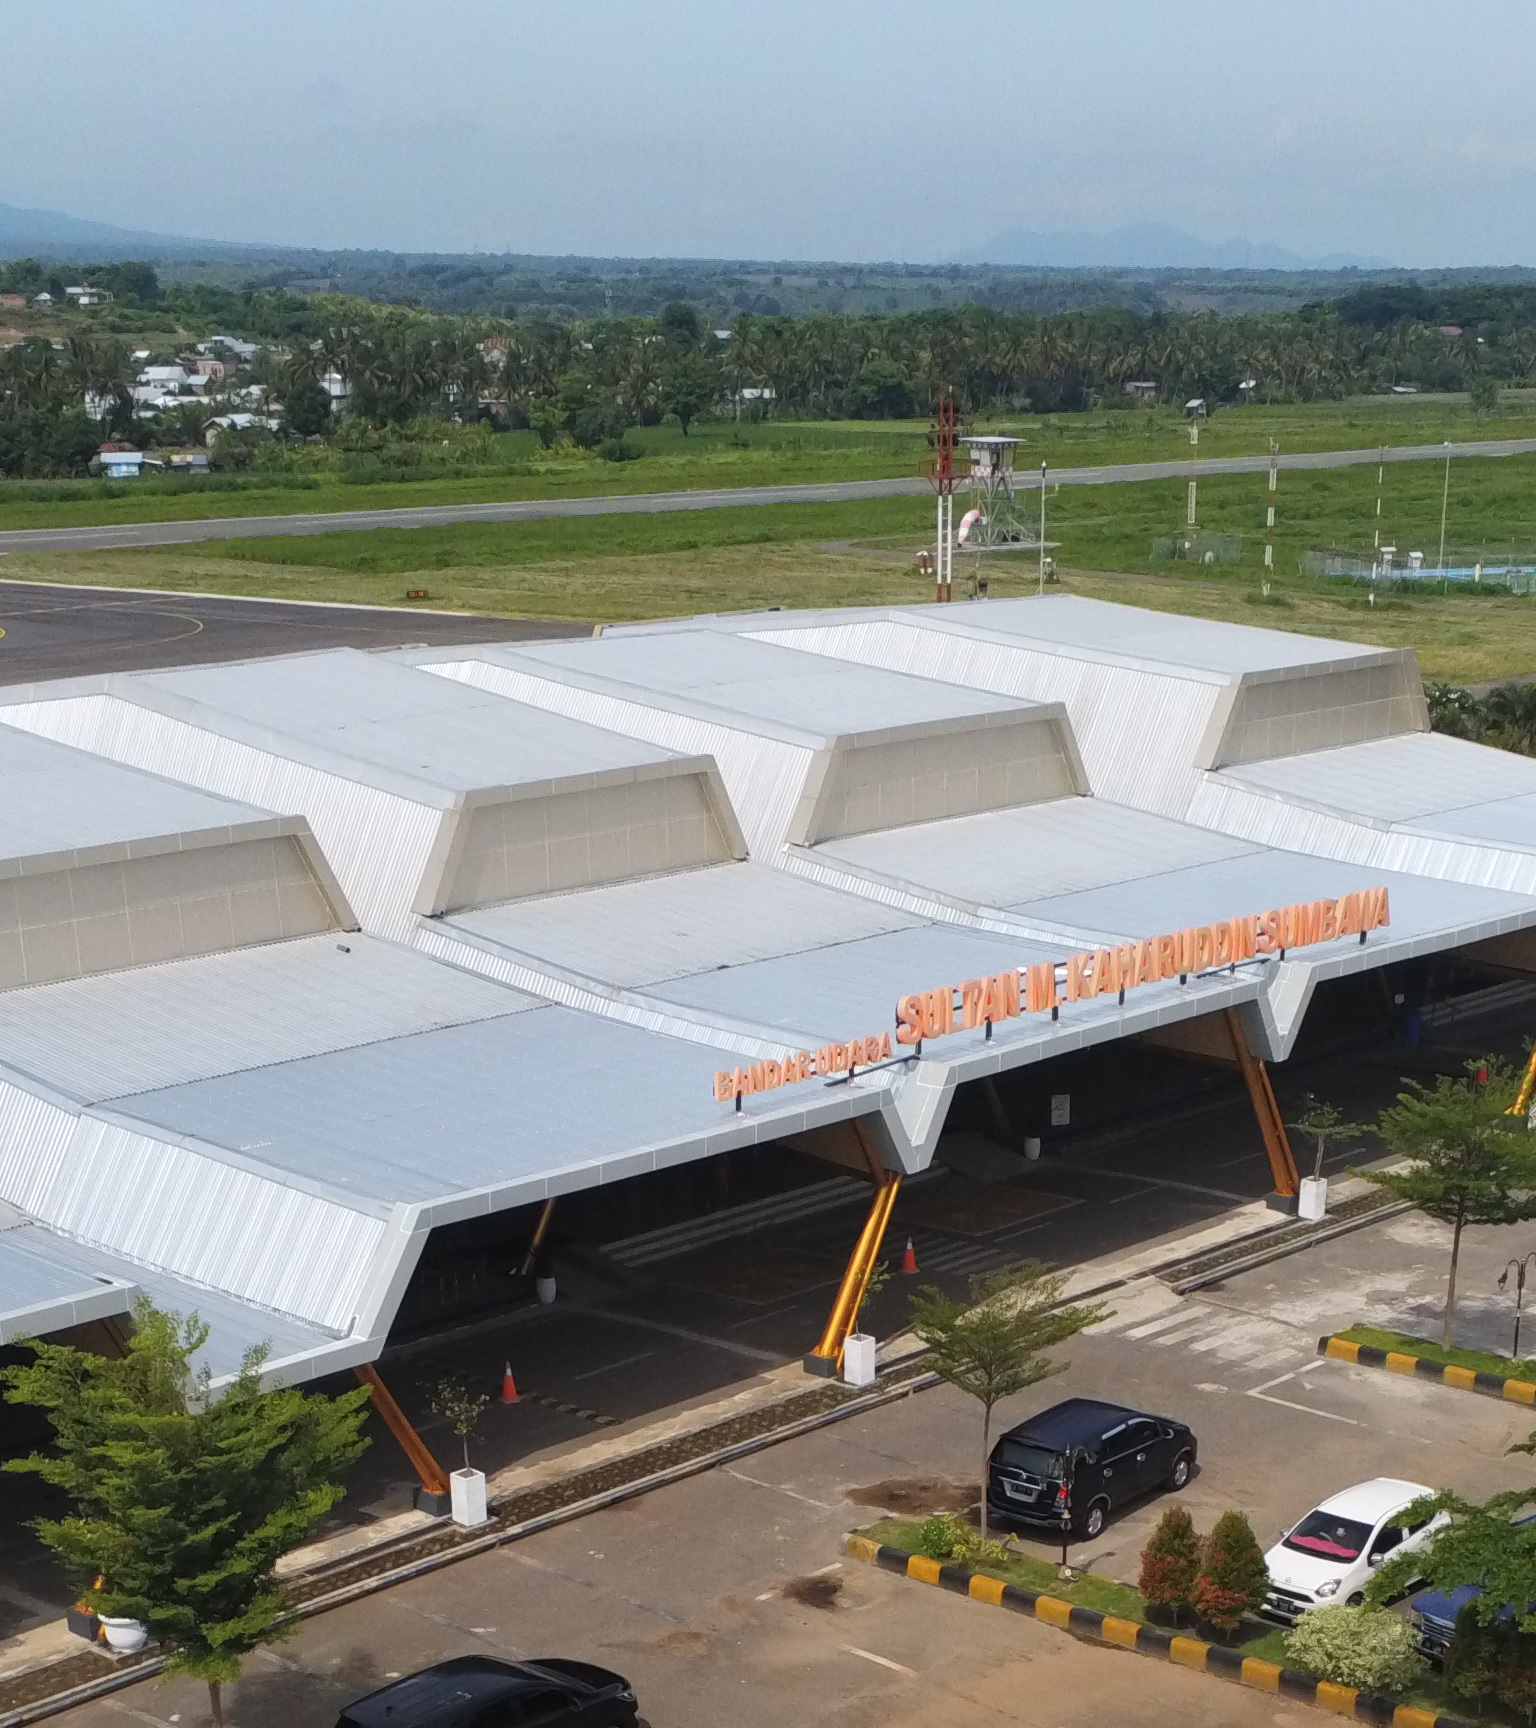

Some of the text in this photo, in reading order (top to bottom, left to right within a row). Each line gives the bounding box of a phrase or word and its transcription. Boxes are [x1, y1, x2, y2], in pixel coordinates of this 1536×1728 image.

[713, 886, 1391, 1102] BANDAR UDARA SULTAN M. KAHARUDDIN SUMBAWA
